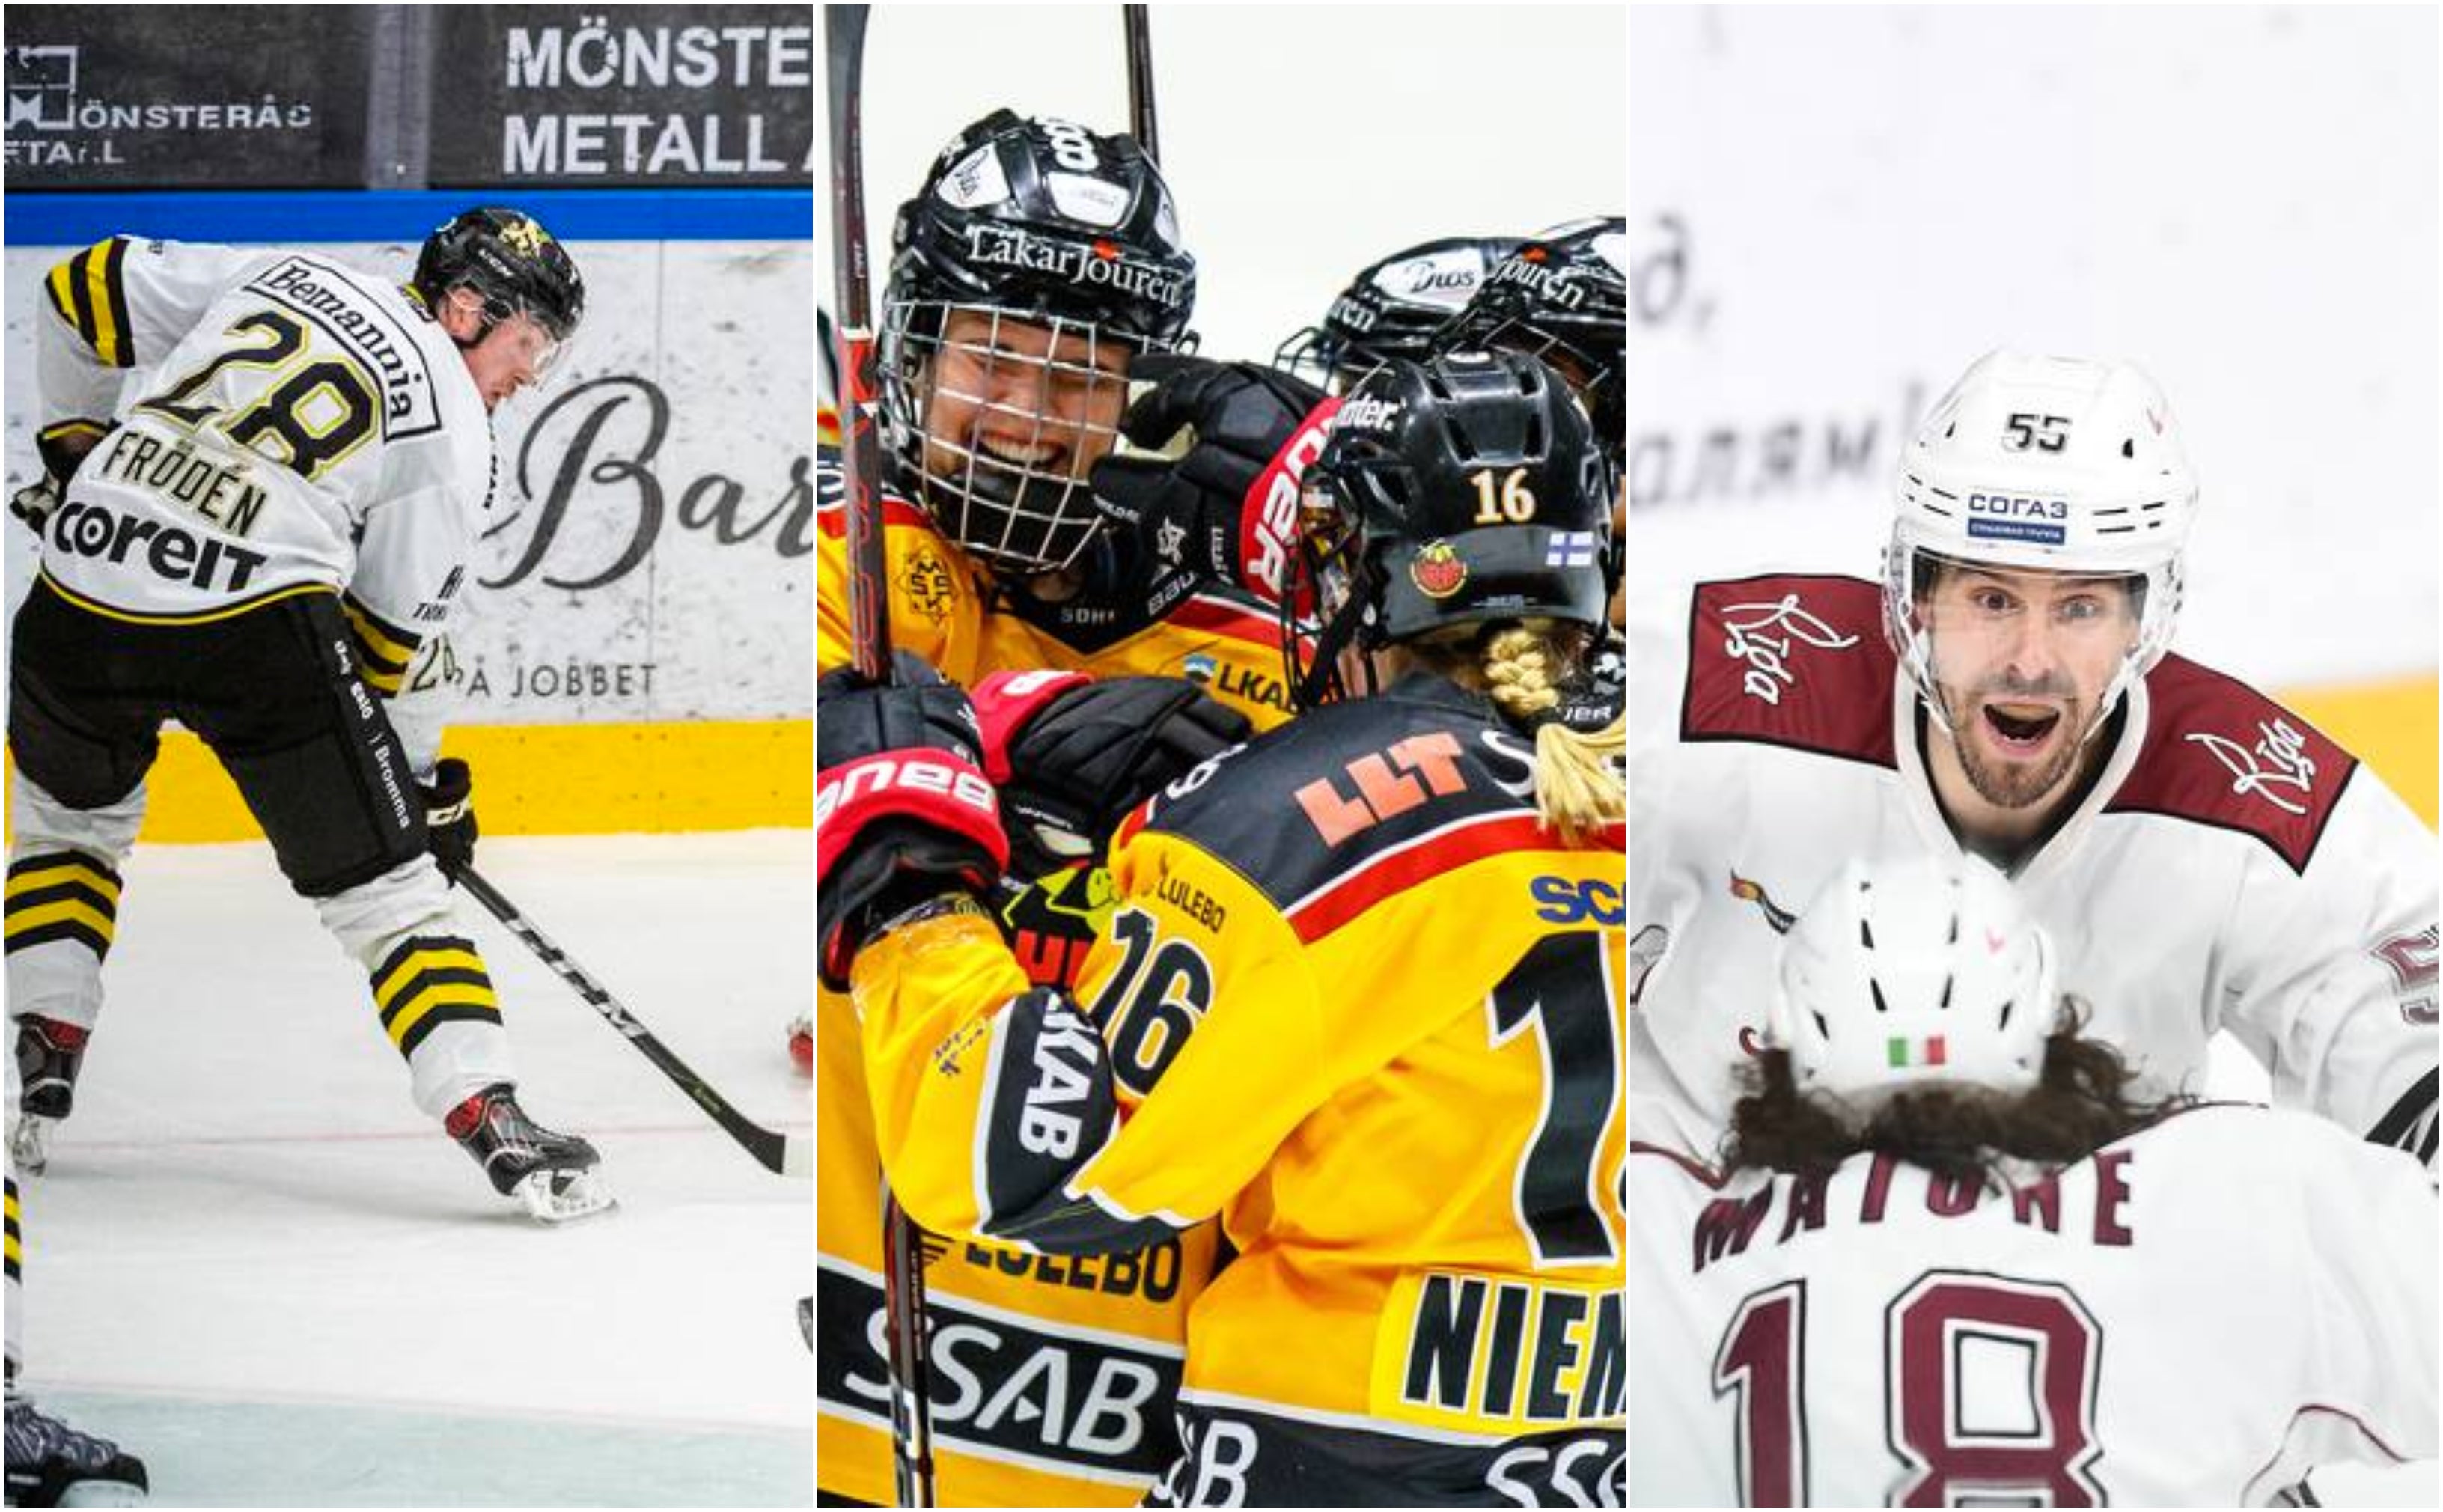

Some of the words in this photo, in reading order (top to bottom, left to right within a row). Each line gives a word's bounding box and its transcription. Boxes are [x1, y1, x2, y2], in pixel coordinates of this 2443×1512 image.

[502, 114, 785, 174] METALL
[129, 307, 382, 483] 28
[266, 263, 418, 421] Bemannia
[2001, 412, 2073, 453] 55
[1470, 467, 1537, 526] 16
[1968, 493, 2068, 519] СОГАЗ
[511, 665, 657, 698] JOBBET
[1294, 731, 1468, 850] LLT
[1531, 875, 1626, 925] SC
[1088, 906, 1214, 1097] 16
[1019, 993, 1099, 1159] KAB
[844, 1306, 1160, 1456] SSAB
[1712, 1268, 2108, 1508] 18
